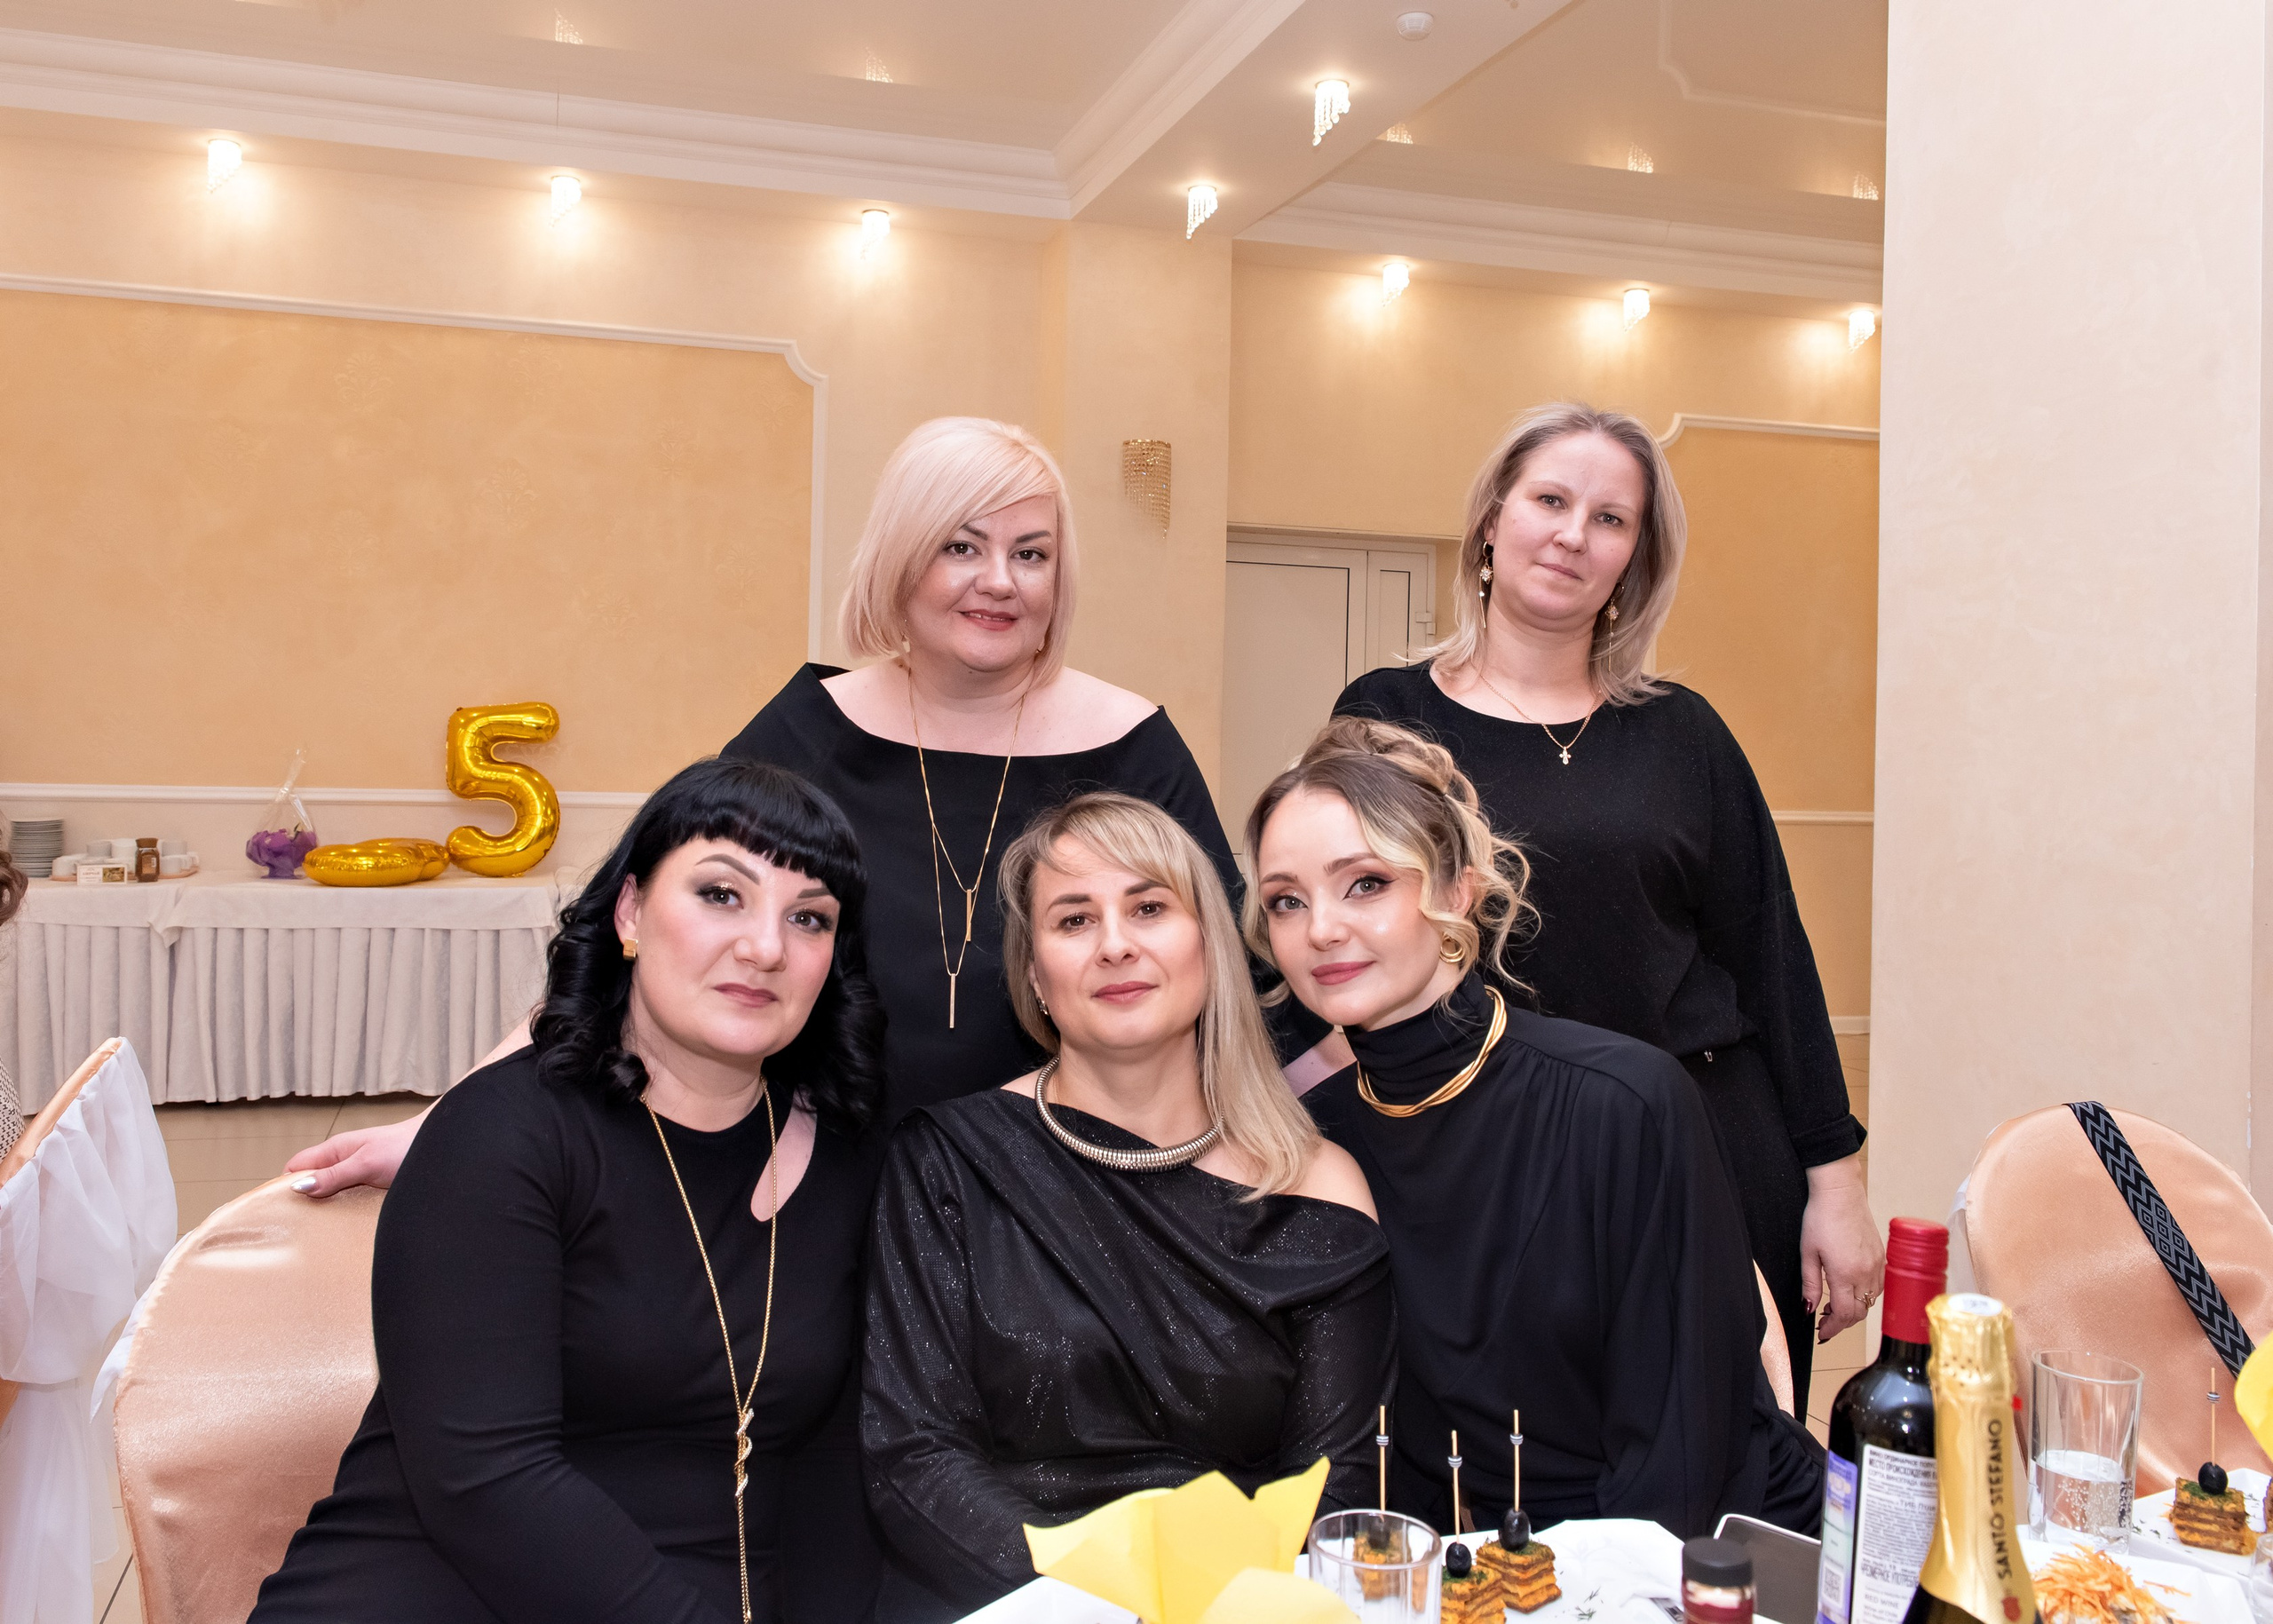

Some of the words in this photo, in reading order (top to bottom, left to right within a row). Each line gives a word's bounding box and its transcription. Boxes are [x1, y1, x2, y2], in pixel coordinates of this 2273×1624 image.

[445, 701, 560, 877] 5
[1988, 1420, 2004, 1507] STEFANO
[1990, 1513, 2013, 1580] SANTO
